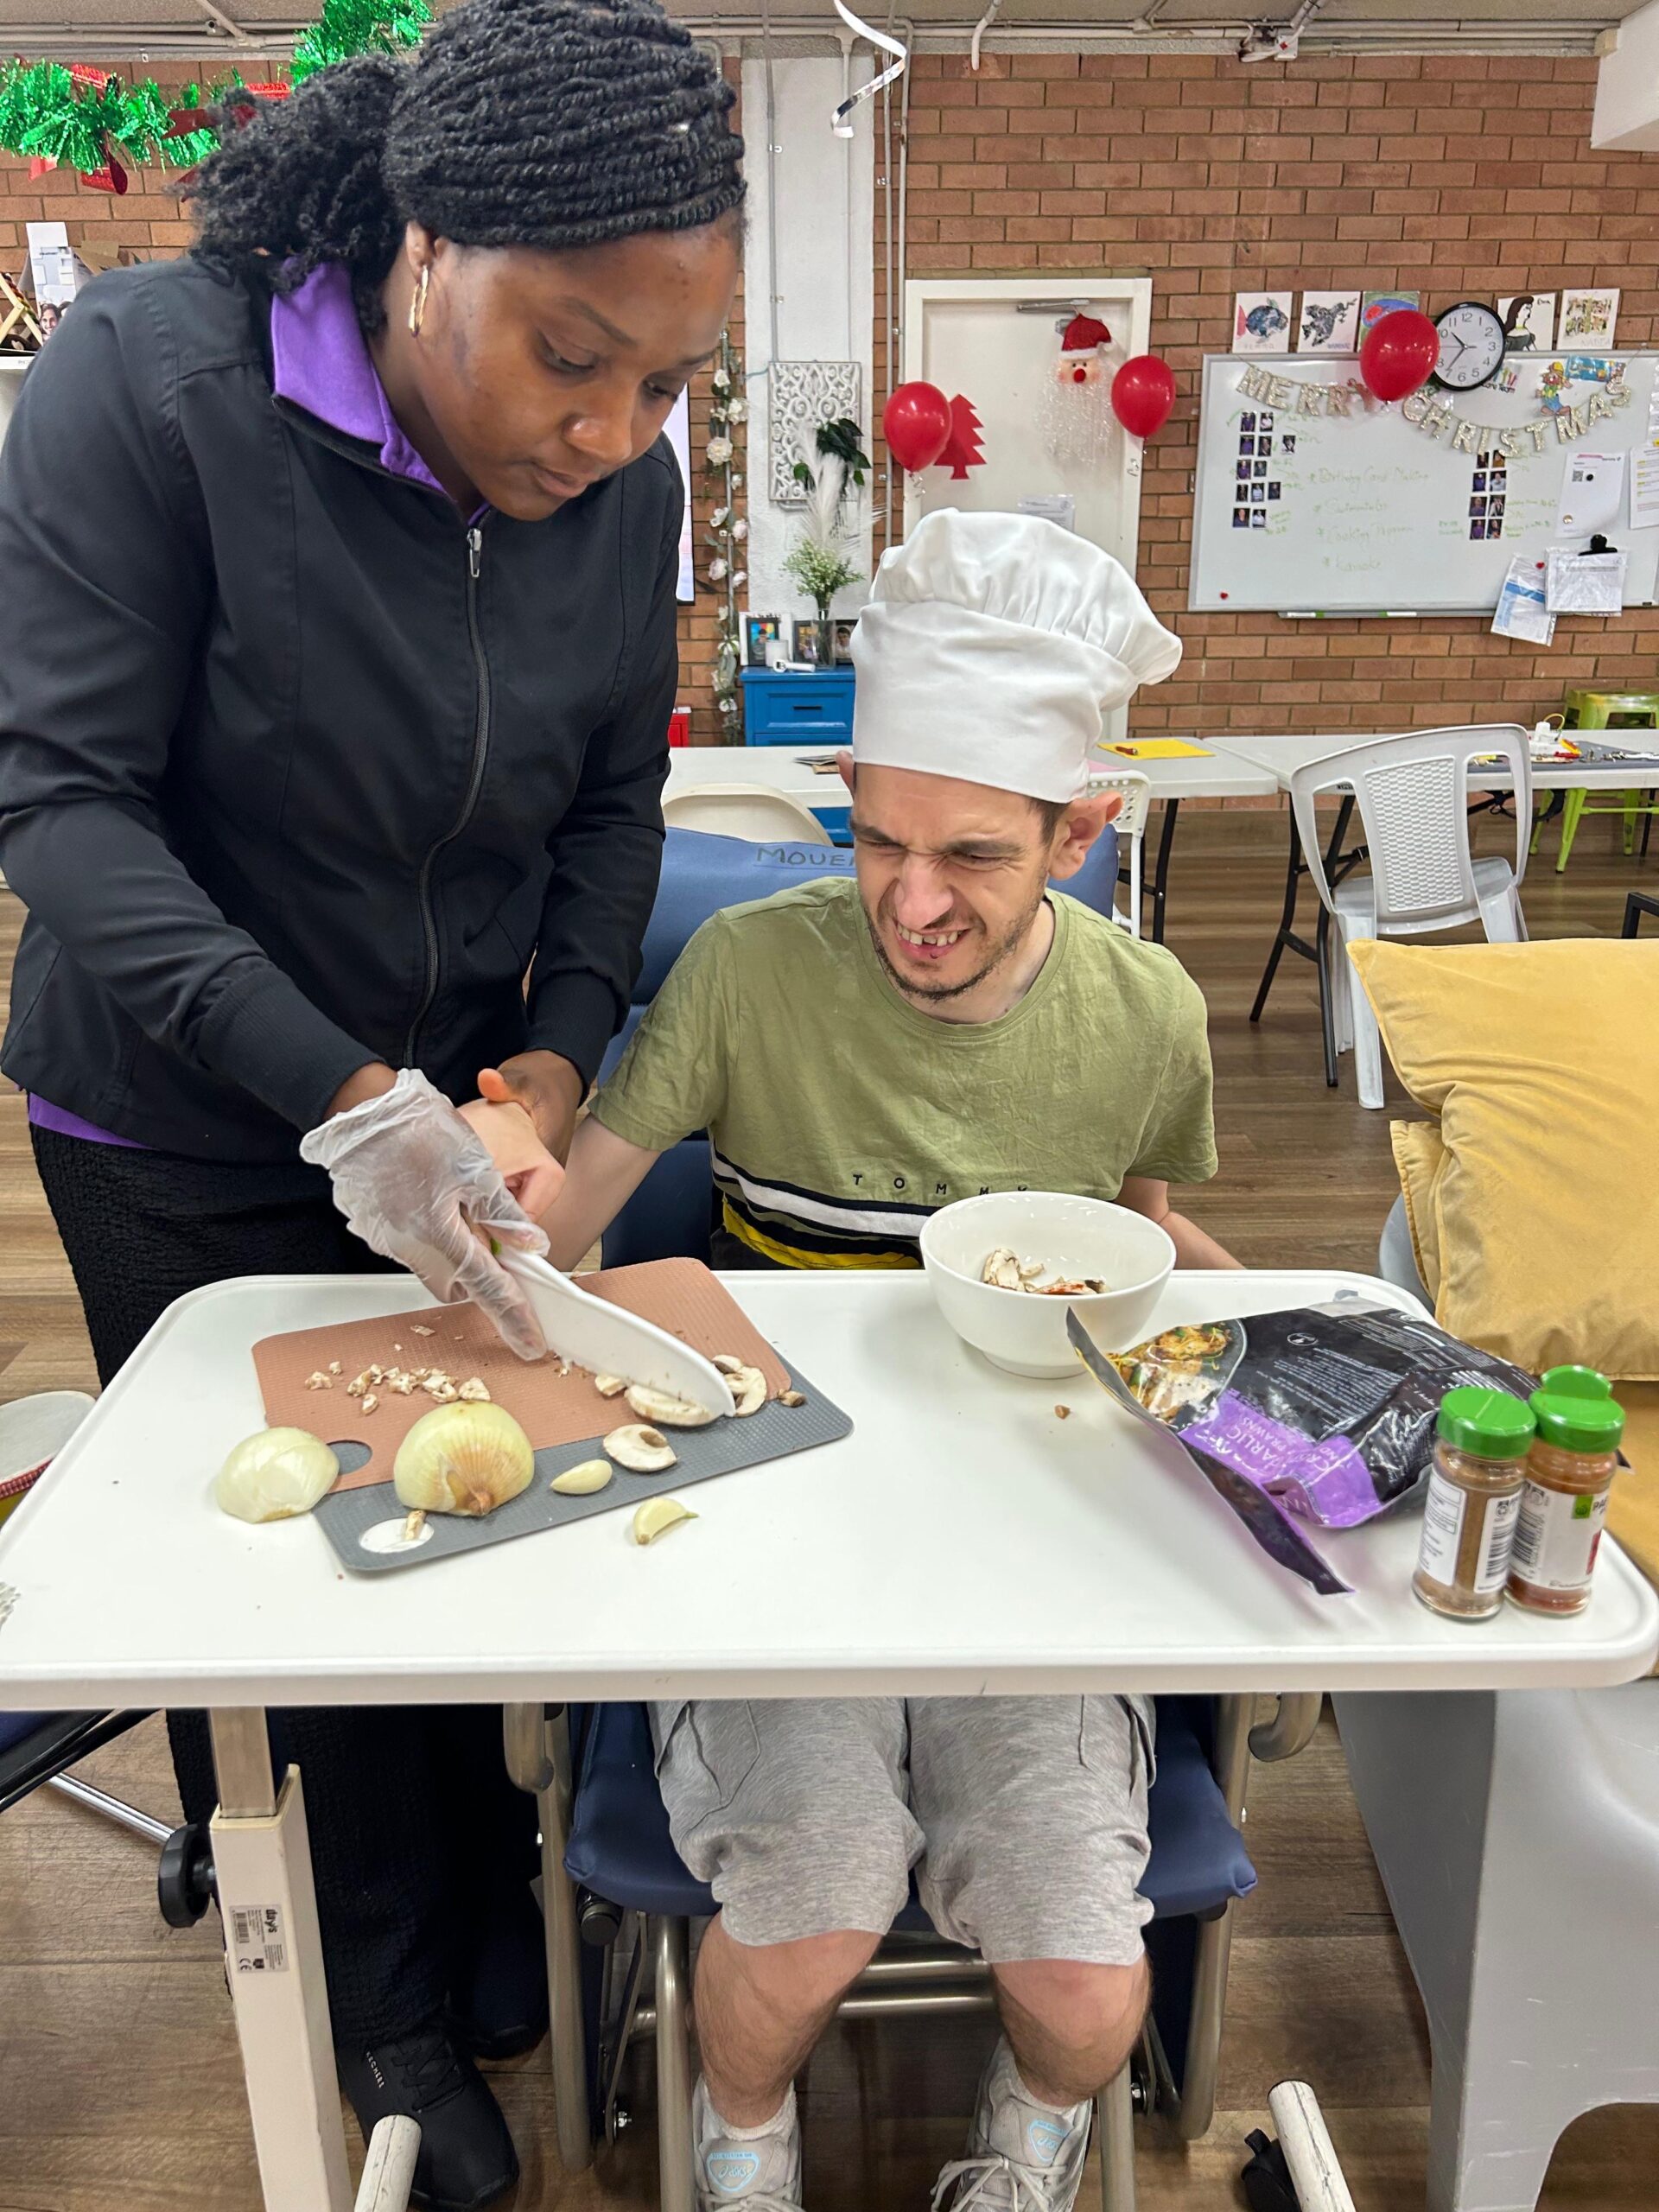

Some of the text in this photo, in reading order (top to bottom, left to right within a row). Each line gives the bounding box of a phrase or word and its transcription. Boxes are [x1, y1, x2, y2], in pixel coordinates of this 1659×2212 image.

[1450, 317, 1456, 327] 11
[1462, 313, 1472, 322] 12
[1478, 315, 1483, 327] 1
[1485, 327, 1493, 336] 2
[1488, 342, 1496, 351] 3
[1483, 357, 1490, 366] 4
[1445, 369, 1452, 378] 7
[1458, 372, 1465, 381] 6
[1472, 368, 1480, 377] 5
[1402, 379, 1632, 459] CHRISTMAS
[1241, 1415, 1287, 1452] PRAWNS
[365, 2050, 385, 2088] KECHERS
